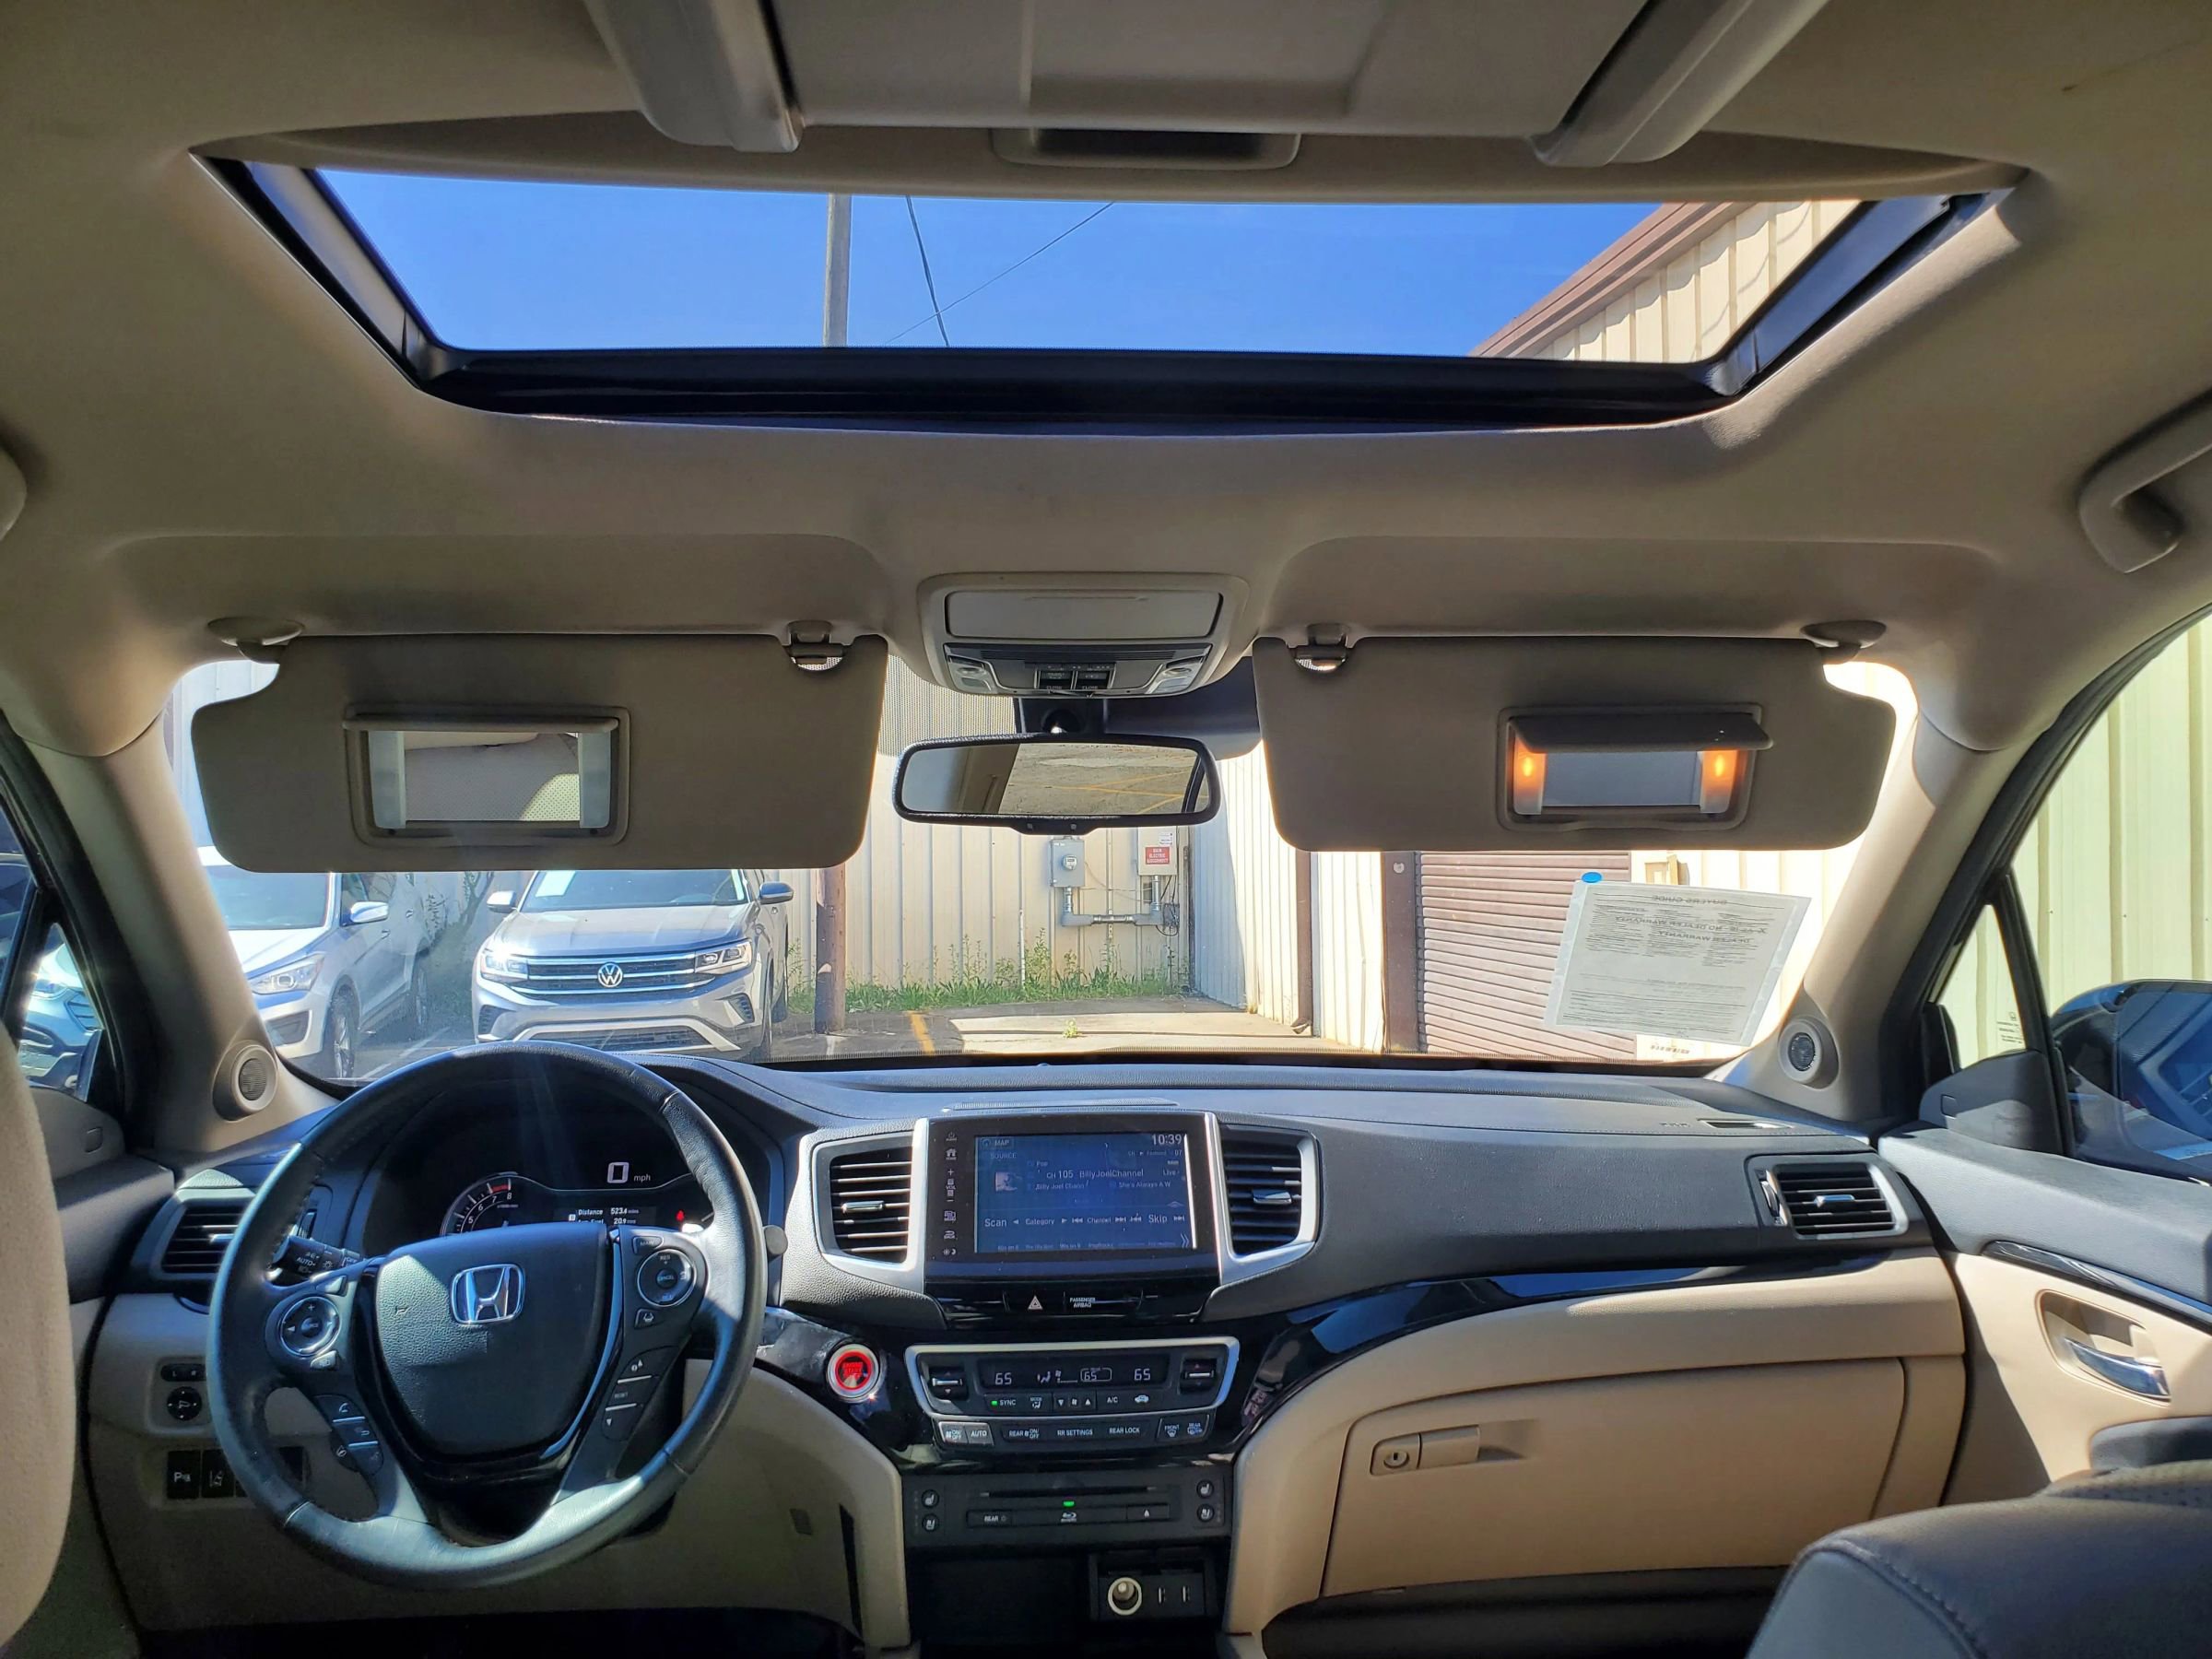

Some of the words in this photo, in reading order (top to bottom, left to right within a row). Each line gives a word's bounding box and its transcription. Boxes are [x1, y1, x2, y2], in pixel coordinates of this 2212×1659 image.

[1151, 1134, 1182, 1146] 10:39
[606, 1161, 629, 1183] 0
[1058, 1170, 1075, 1180] 105
[633, 1173, 652, 1183] mph
[491, 1195, 498, 1204] 7
[477, 1204, 484, 1212] 6
[467, 1216, 475, 1224] 5
[984, 1218, 1007, 1228] Scan
[1025, 1218, 1055, 1226] Category
[1148, 1214, 1168, 1224] Skip
[296, 1256, 313, 1266] AUTO
[995, 1372, 1012, 1385] 65
[1084, 1371, 1098, 1382] 65
[1134, 1368, 1151, 1382] 65
